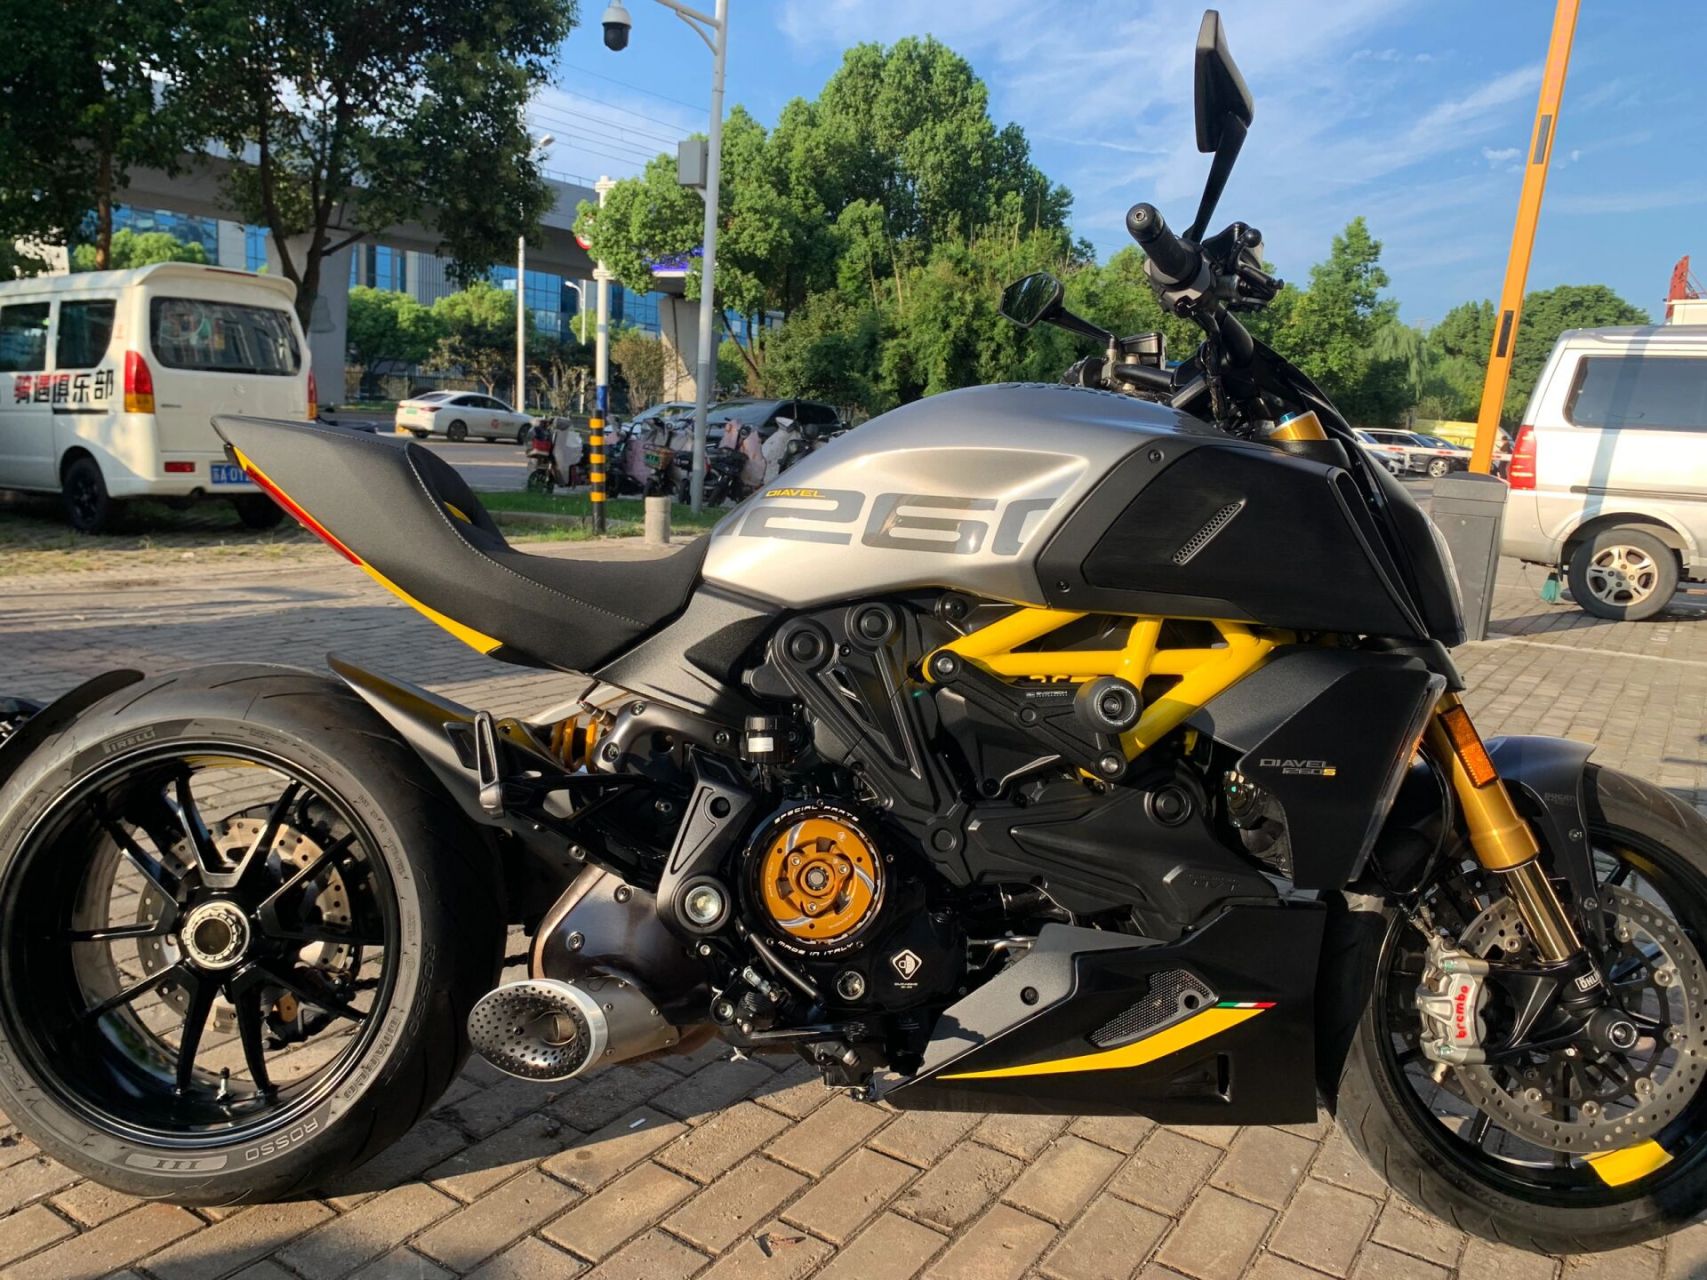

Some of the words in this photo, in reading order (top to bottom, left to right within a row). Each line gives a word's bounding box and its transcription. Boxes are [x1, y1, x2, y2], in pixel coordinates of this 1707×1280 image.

[765, 488, 826, 498] DIAVEL
[101, 727, 155, 754] PIRELLI
[1259, 758, 1336, 768] DIAVEL
[823, 805, 859, 822] PARTS
[777, 940, 806, 955] MADE
[1455, 985, 1470, 1039] brembo
[245, 1117, 319, 1161] ROSSO
[154, 1159, 196, 1170] III
